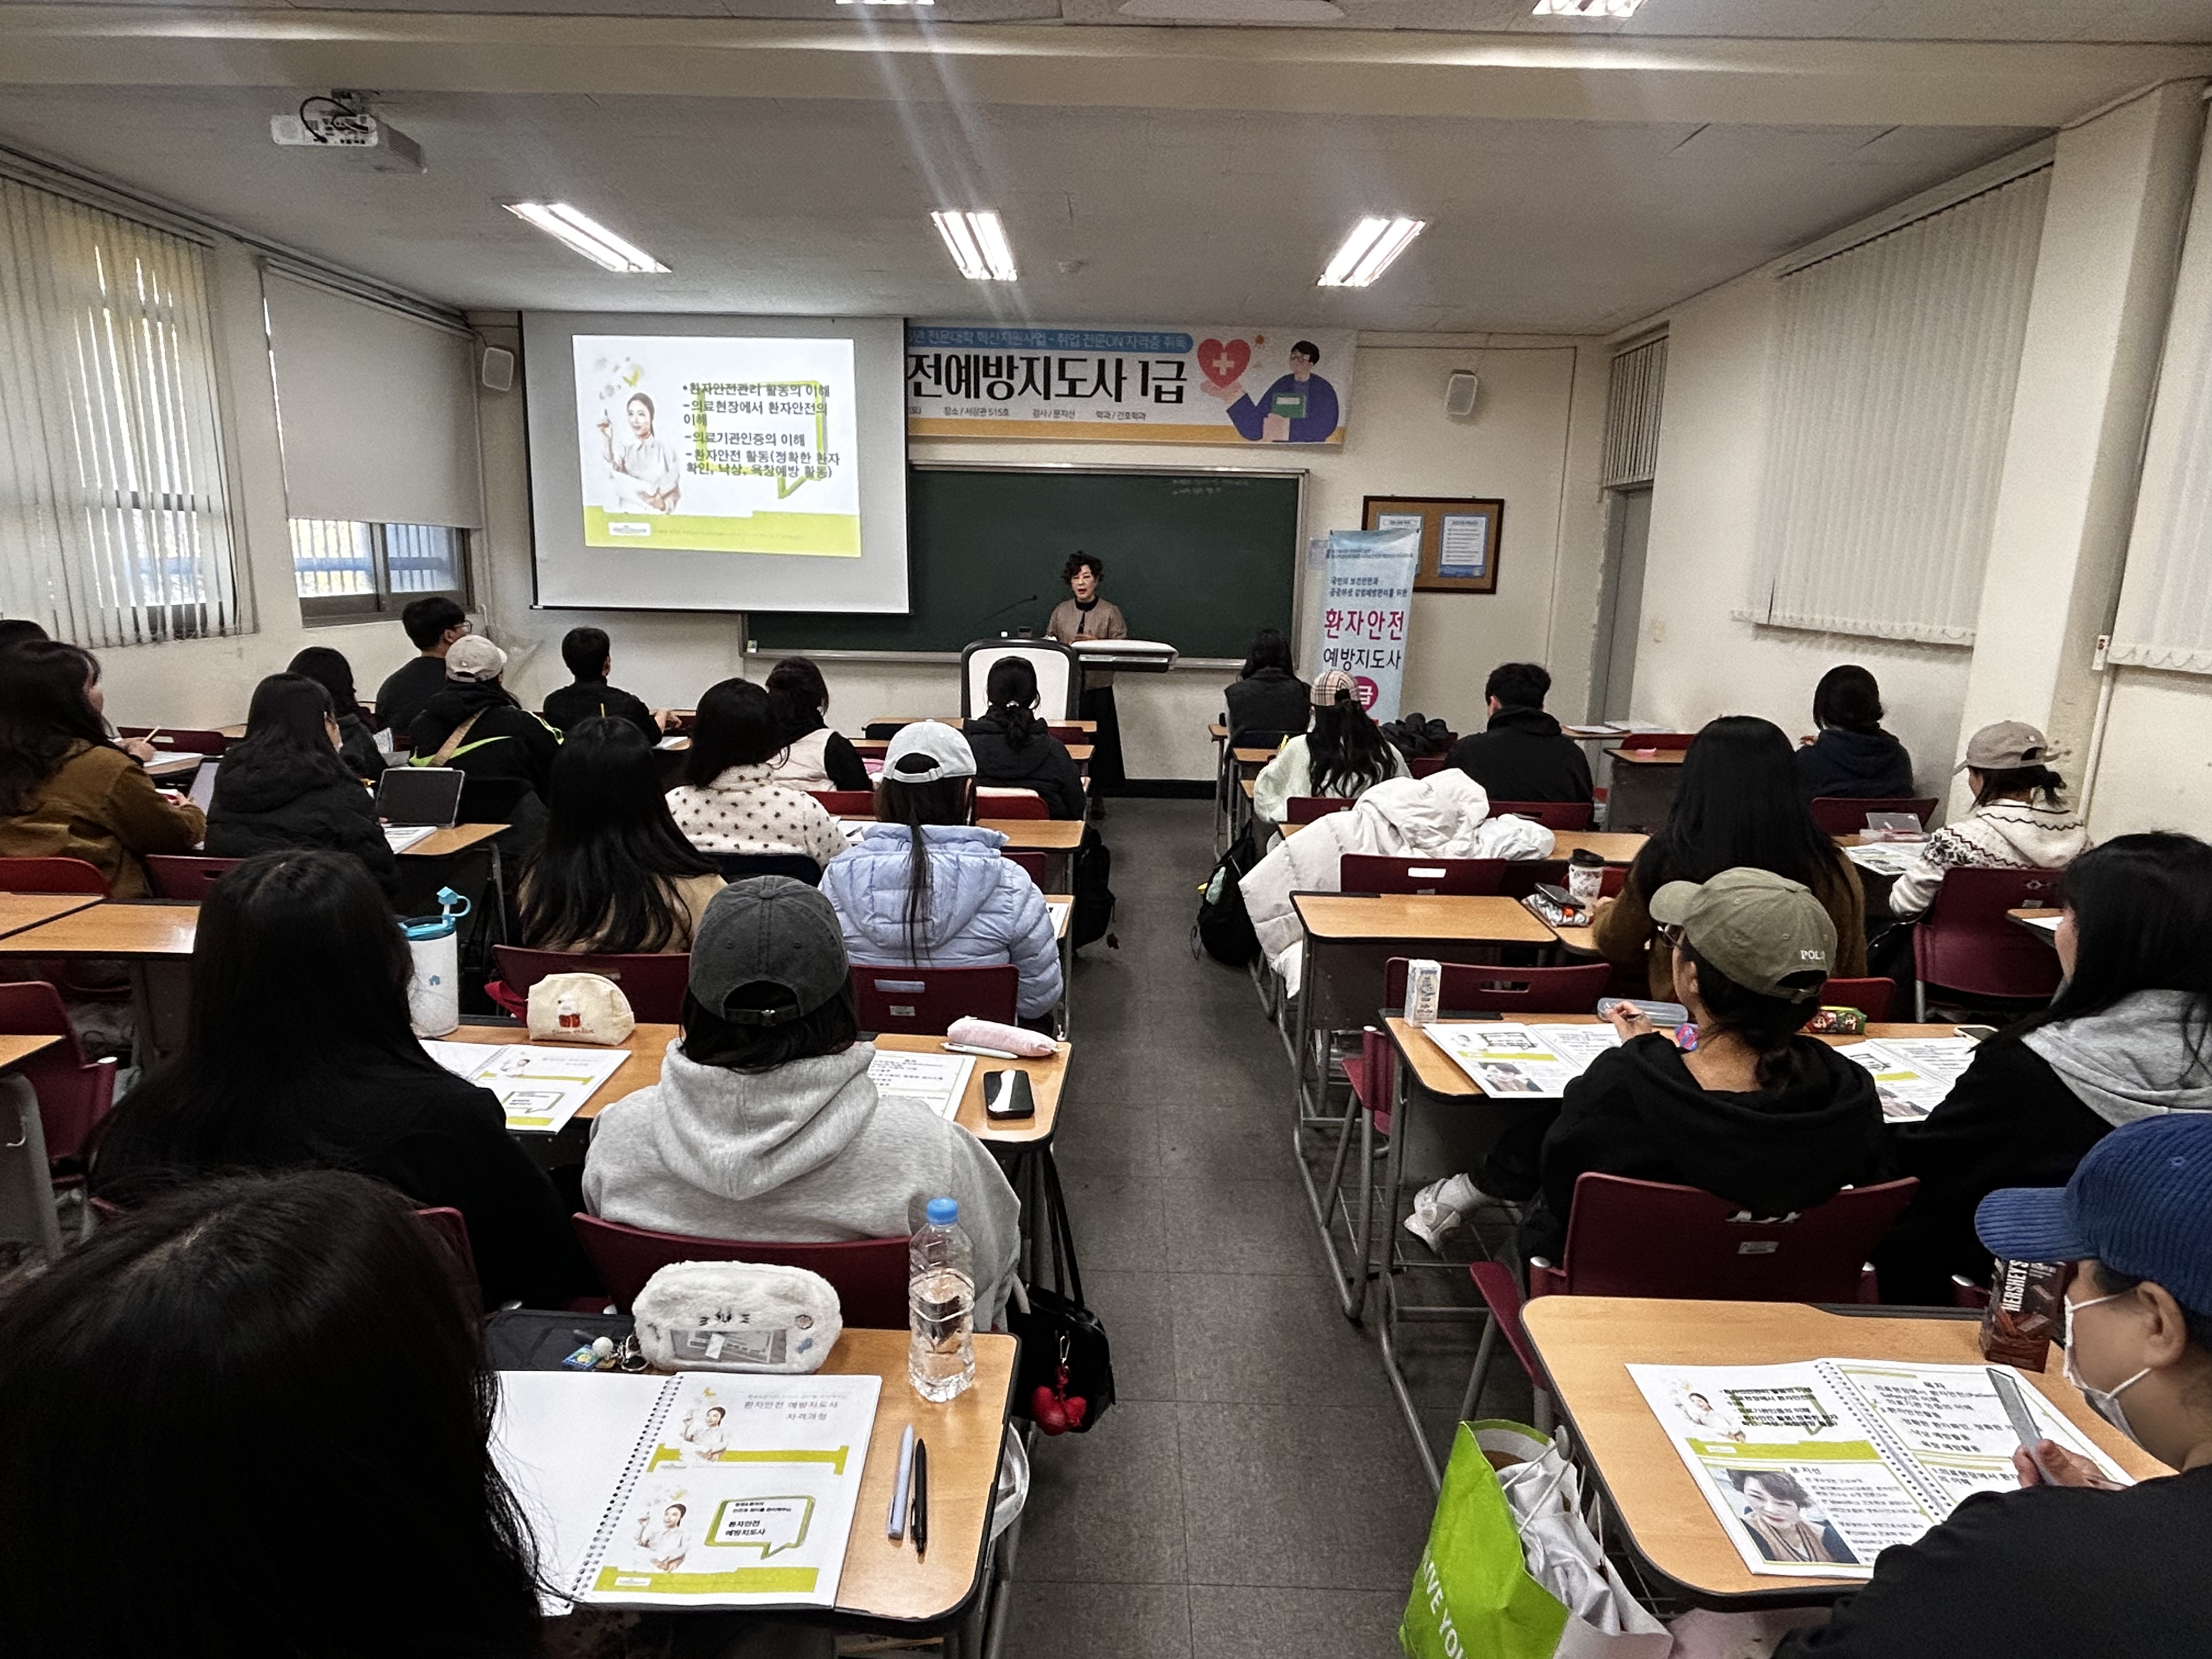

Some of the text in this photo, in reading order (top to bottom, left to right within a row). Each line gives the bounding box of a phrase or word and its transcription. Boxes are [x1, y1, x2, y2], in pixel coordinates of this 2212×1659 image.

[977, 331, 1047, 347] 혁신지원사업
[1058, 333, 1079, 347] 취업
[1126, 335, 1161, 349] 자격증
[1164, 335, 1187, 350] 취득
[1138, 358, 1187, 404] 1급
[690, 382, 830, 398] 환자안전관리 활동의 이해
[769, 401, 827, 415] 환자안전의
[684, 413, 707, 426] 이해
[781, 433, 805, 447] 이해
[817, 452, 840, 465] 환자
[1324, 608, 1404, 641] 환자안전
[1323, 647, 1401, 672] 예방지도사
